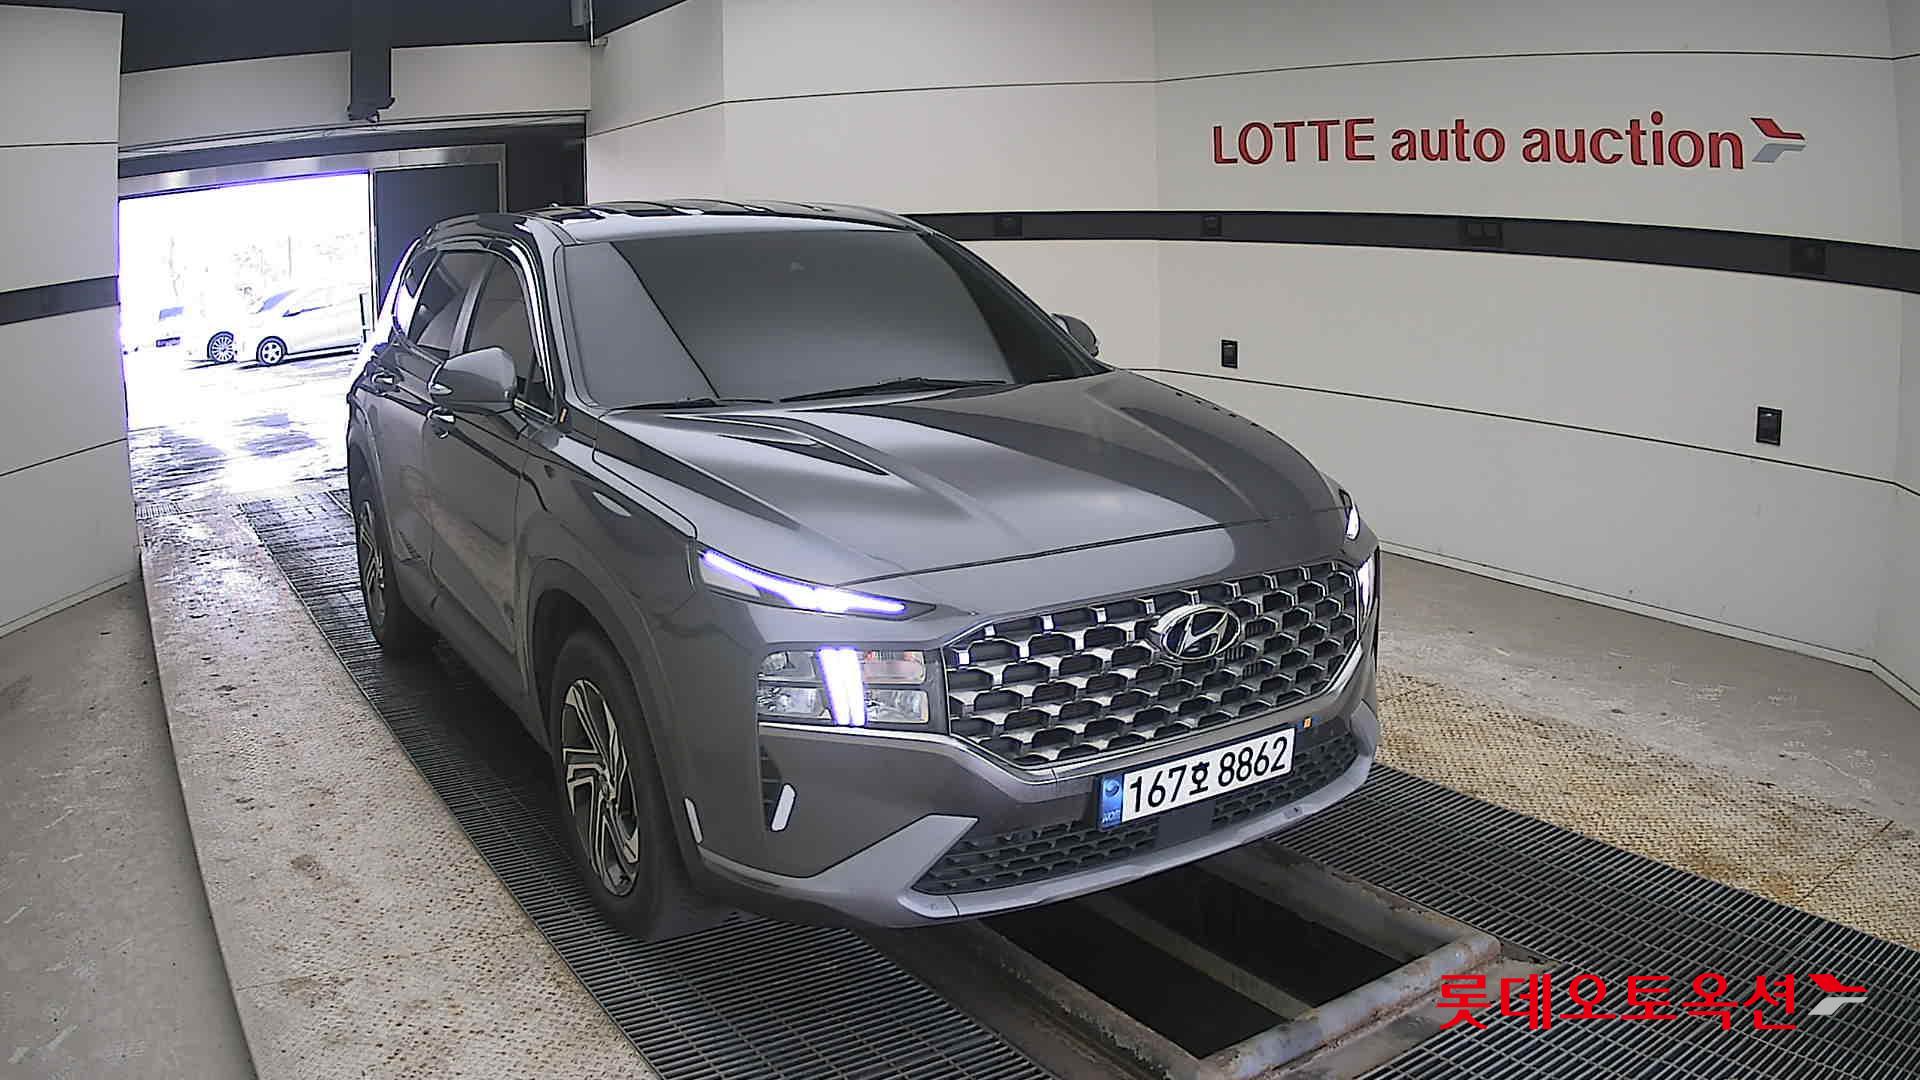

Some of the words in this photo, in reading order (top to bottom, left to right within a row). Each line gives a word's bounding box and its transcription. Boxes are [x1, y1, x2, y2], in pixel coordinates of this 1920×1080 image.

[1213, 118, 1375, 164] LOTTE
[1391, 119, 1506, 162] auto
[1522, 111, 1744, 169] auction
[1130, 762, 1209, 812] 167호
[1218, 736, 1287, 786] 8862
